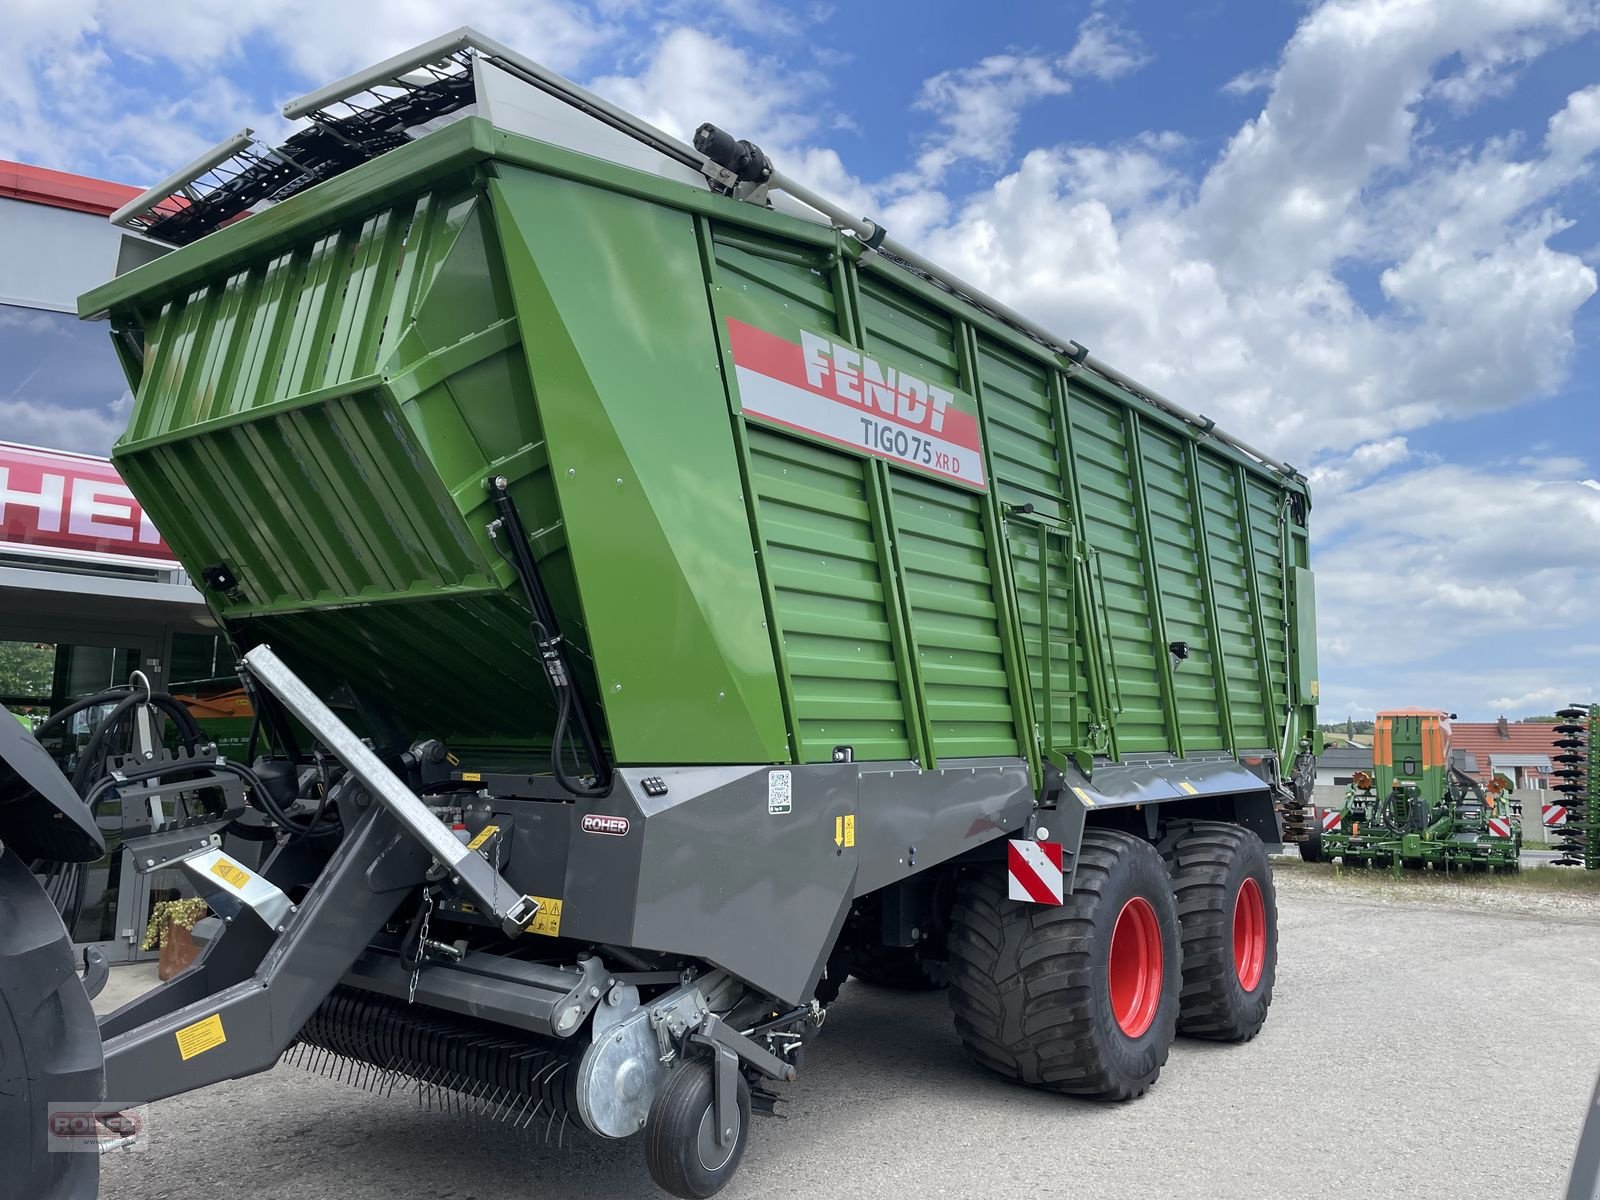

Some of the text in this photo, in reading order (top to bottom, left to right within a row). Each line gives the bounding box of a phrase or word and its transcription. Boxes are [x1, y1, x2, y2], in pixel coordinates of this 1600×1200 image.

[800, 329, 954, 433] FENDT
[860, 417, 908, 457] TIGO
[911, 436, 932, 464] 75
[0, 466, 160, 545] HE
[584, 817, 626, 833] ROHER
